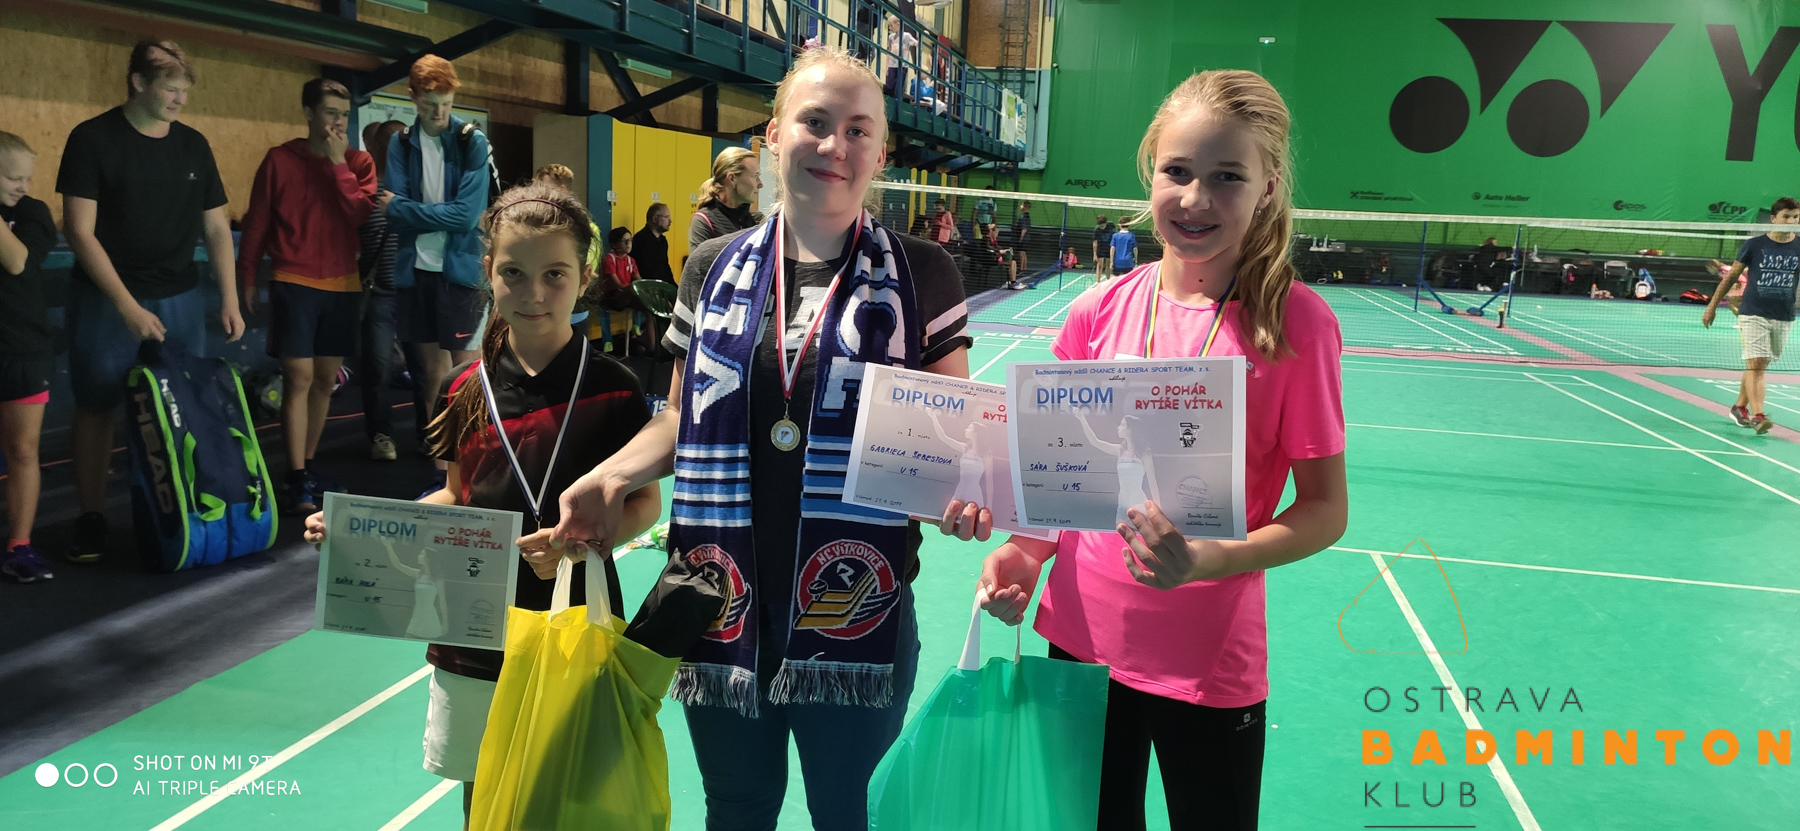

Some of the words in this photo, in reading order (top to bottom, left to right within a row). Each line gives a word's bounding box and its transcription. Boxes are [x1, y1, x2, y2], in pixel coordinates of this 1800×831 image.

[1705, 24, 1800, 162] Y
[1065, 178, 1108, 189] AIREKO
[1036, 387, 1114, 405] DIPLOM
[1150, 385, 1161, 397] O
[1164, 382, 1207, 396] POHÁR
[892, 387, 965, 411] DIPLOM
[1135, 398, 1179, 410] RYTÍŘE
[1184, 398, 1223, 410] VÍTKA
[997, 404, 1006, 412] O
[983, 411, 1008, 423] RYTÍ
[870, 444, 906, 457] GABRIELA
[349, 517, 417, 537] DIPLOM
[447, 526, 456, 535] O
[458, 527, 492, 539] POHÁR
[433, 536, 470, 547] RYTÍŘE
[473, 539, 504, 551] VÍTKA
[816, 548, 834, 566] HC
